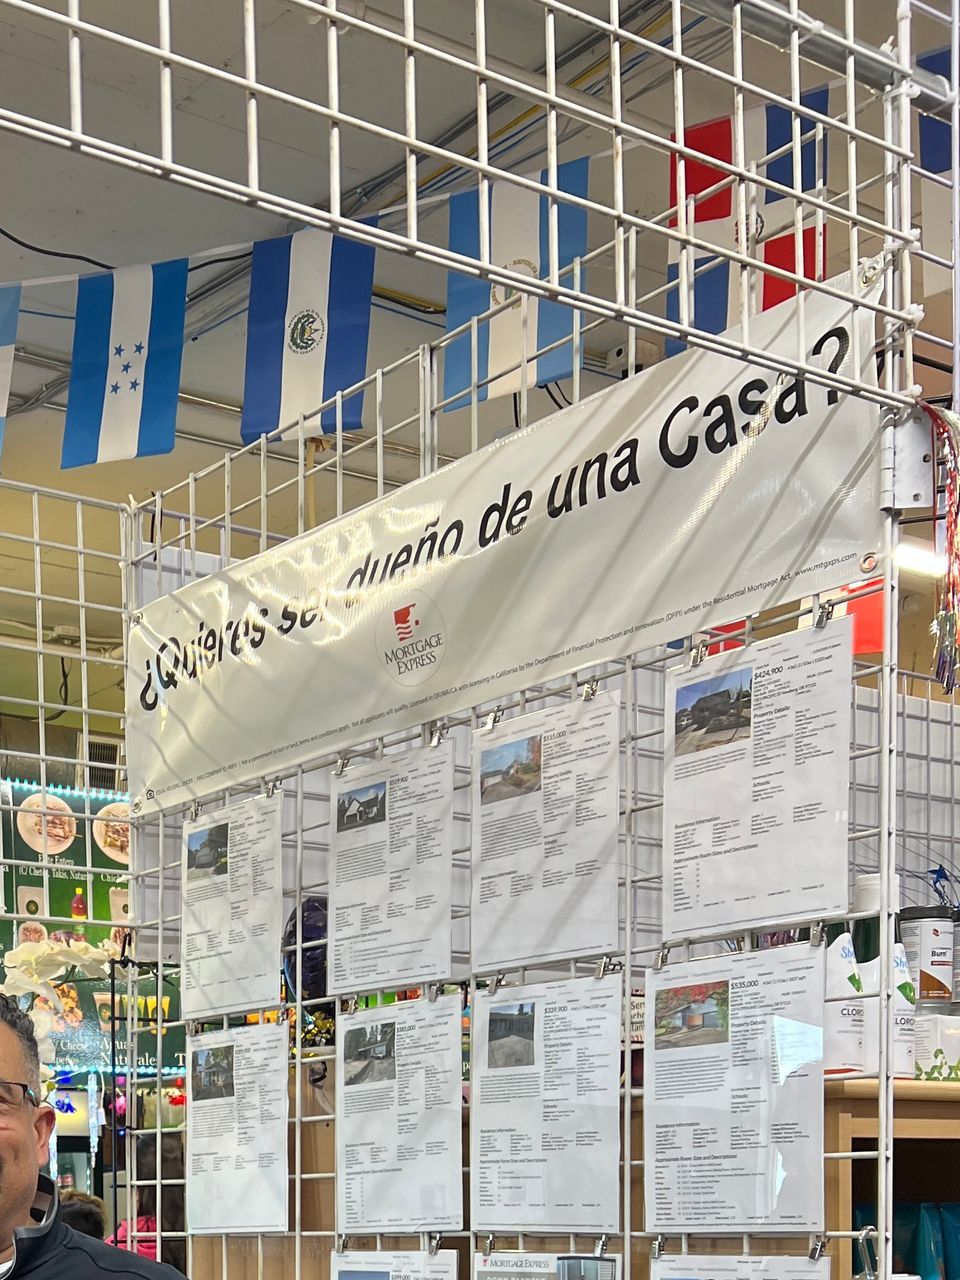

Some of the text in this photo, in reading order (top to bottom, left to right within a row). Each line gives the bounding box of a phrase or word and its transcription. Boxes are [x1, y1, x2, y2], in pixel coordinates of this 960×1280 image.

[478, 484, 530, 549] de
[546, 436, 640, 520] una
[658, 325, 852, 470] Casa?
[496, 668, 518, 680] California
[519, 662, 525, 672] by
[525, 660, 534, 669] the
[535, 649, 565, 667] Department
[565, 647, 571, 655] of
[572, 640, 595, 655] Financial
[595, 630, 623, 646] Protection
[623, 626, 634, 635] and
[635, 616, 665, 632] Innovation
[684, 604, 701, 616] under
[702, 599, 713, 608] the
[713, 587, 747, 606] Residential
[747, 576, 779, 595] Mortgage
[795, 551, 858, 577] www.mtgxps.com
[384, 633, 444, 665] MORTGAGE
[396, 650, 437, 676] EXPRESS
[754, 665, 784, 681] $424,900
